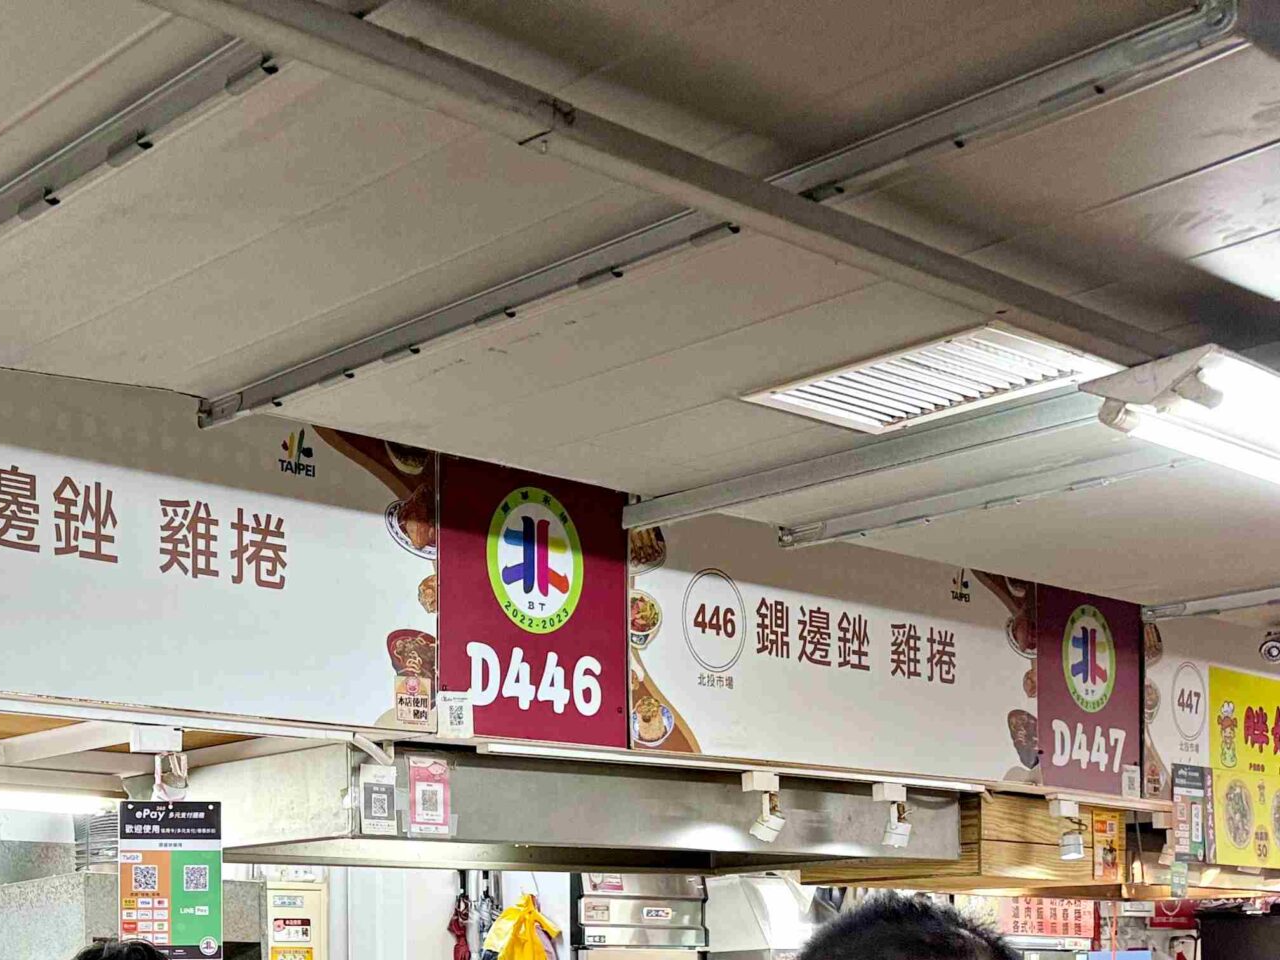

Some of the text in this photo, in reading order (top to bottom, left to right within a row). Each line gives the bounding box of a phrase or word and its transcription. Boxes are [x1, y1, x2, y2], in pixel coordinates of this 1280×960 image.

[278, 458, 316, 478] TAIPEI
[159, 498, 287, 590] 雞捲
[504, 600, 569, 629] 2022-2023
[693, 603, 736, 638] 446
[890, 622, 956, 685] 雞捲
[466, 641, 602, 717] D446
[697, 673, 734, 690] 北投市場
[1177, 689, 1202, 715] 447
[1051, 719, 1126, 773] D447
[125, 824, 160, 834] 歡迎使用
[135, 808, 166, 822] ePay
